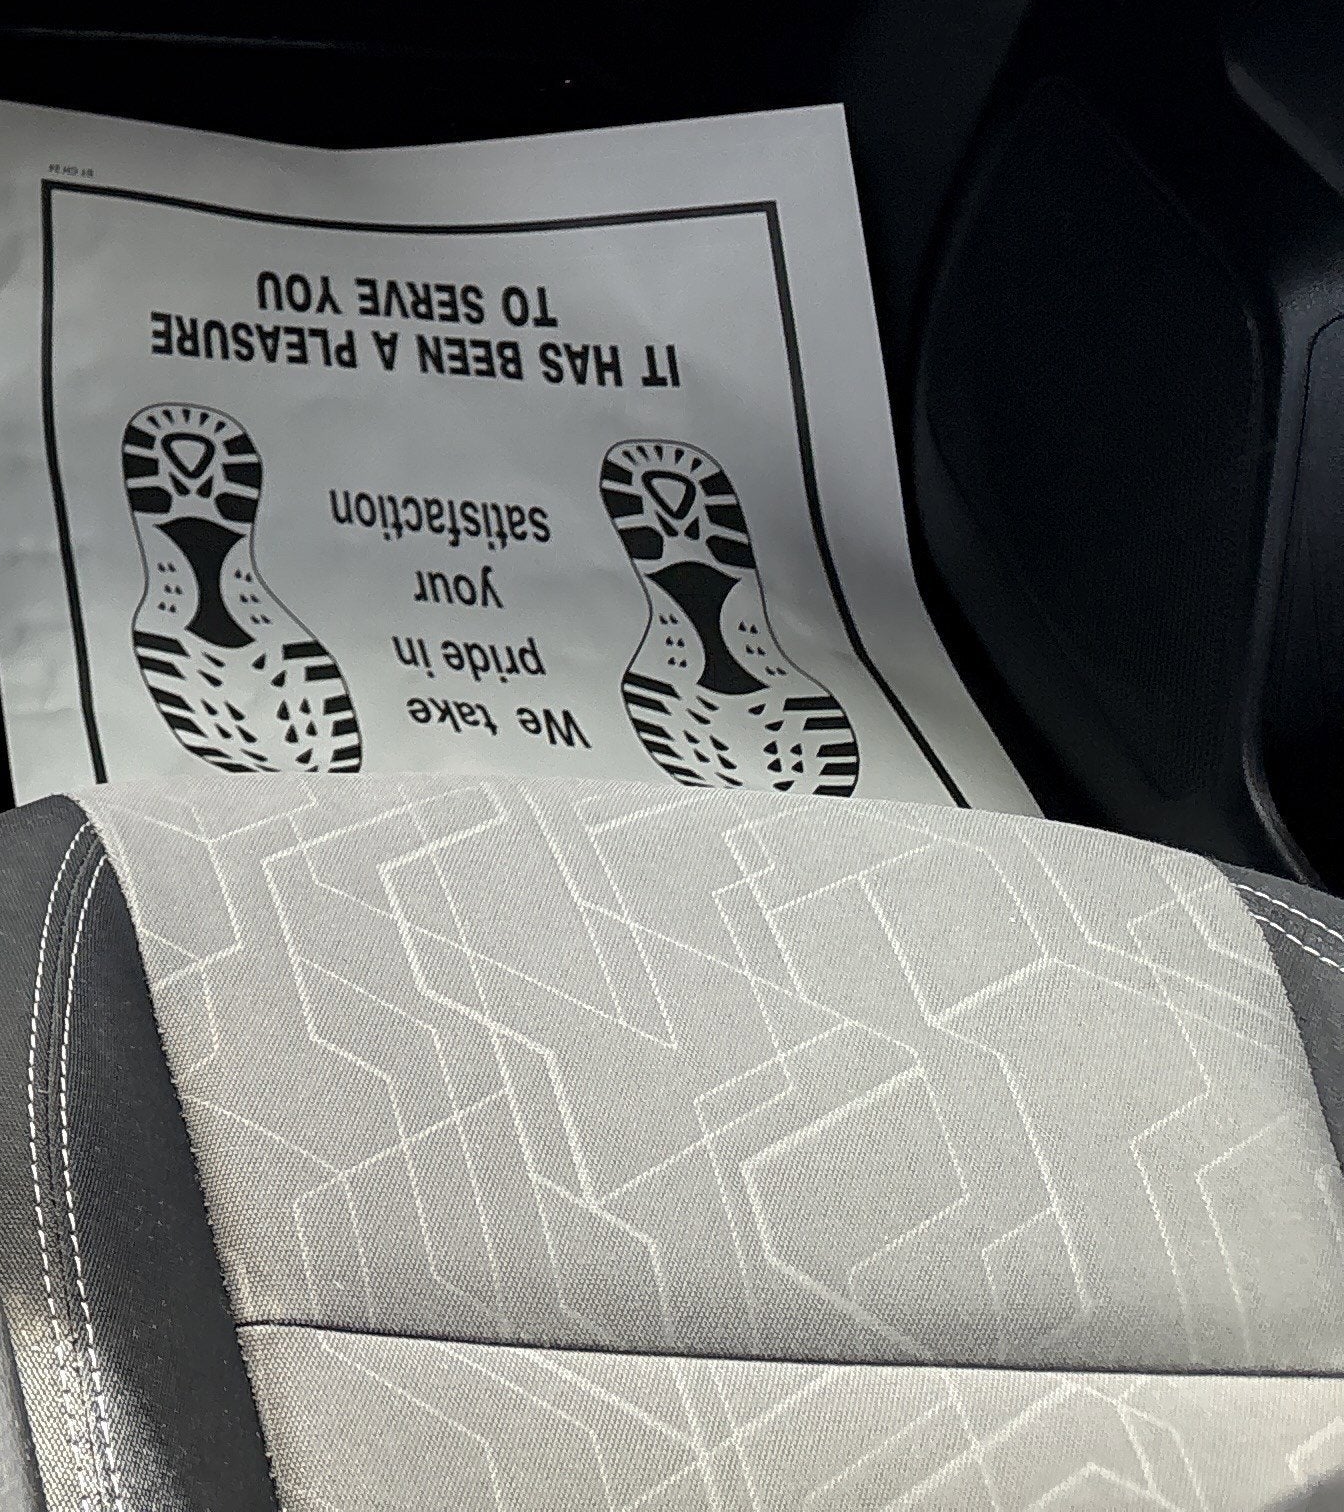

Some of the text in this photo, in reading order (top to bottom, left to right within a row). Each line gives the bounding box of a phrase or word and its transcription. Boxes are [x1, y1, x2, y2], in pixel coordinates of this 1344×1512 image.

[256, 270, 559, 328] TO SERVE YOU
[150, 311, 681, 388] IT HAS BEEN A PLEASURE
[329, 488, 551, 551] satisfaction
[414, 565, 505, 609] your
[392, 636, 546, 683] pride in
[406, 697, 592, 749] We take
